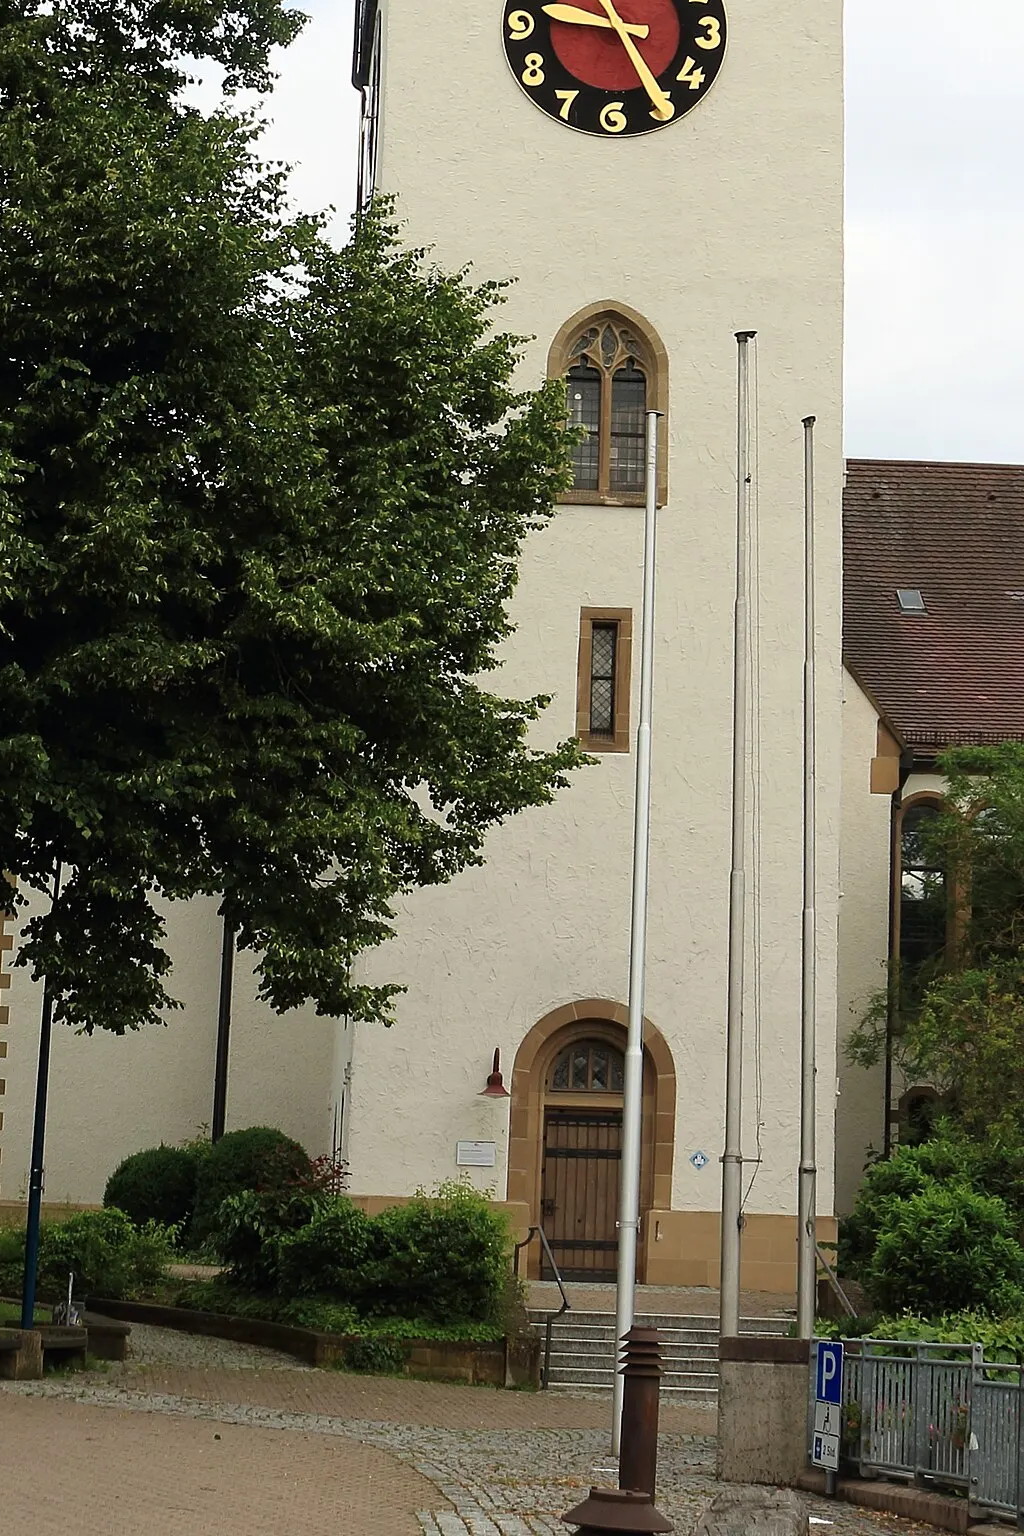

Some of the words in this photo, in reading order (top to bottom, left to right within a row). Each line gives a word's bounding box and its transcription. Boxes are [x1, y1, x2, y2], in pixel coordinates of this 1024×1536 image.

[507, 10, 535, 40] 9
[694, 16, 721, 50] 3
[522, 52, 545, 86] 8
[676, 55, 706, 90] 4
[555, 89, 579, 120] 7
[600, 102, 627, 133] 6
[822, 1351, 836, 1397] P
